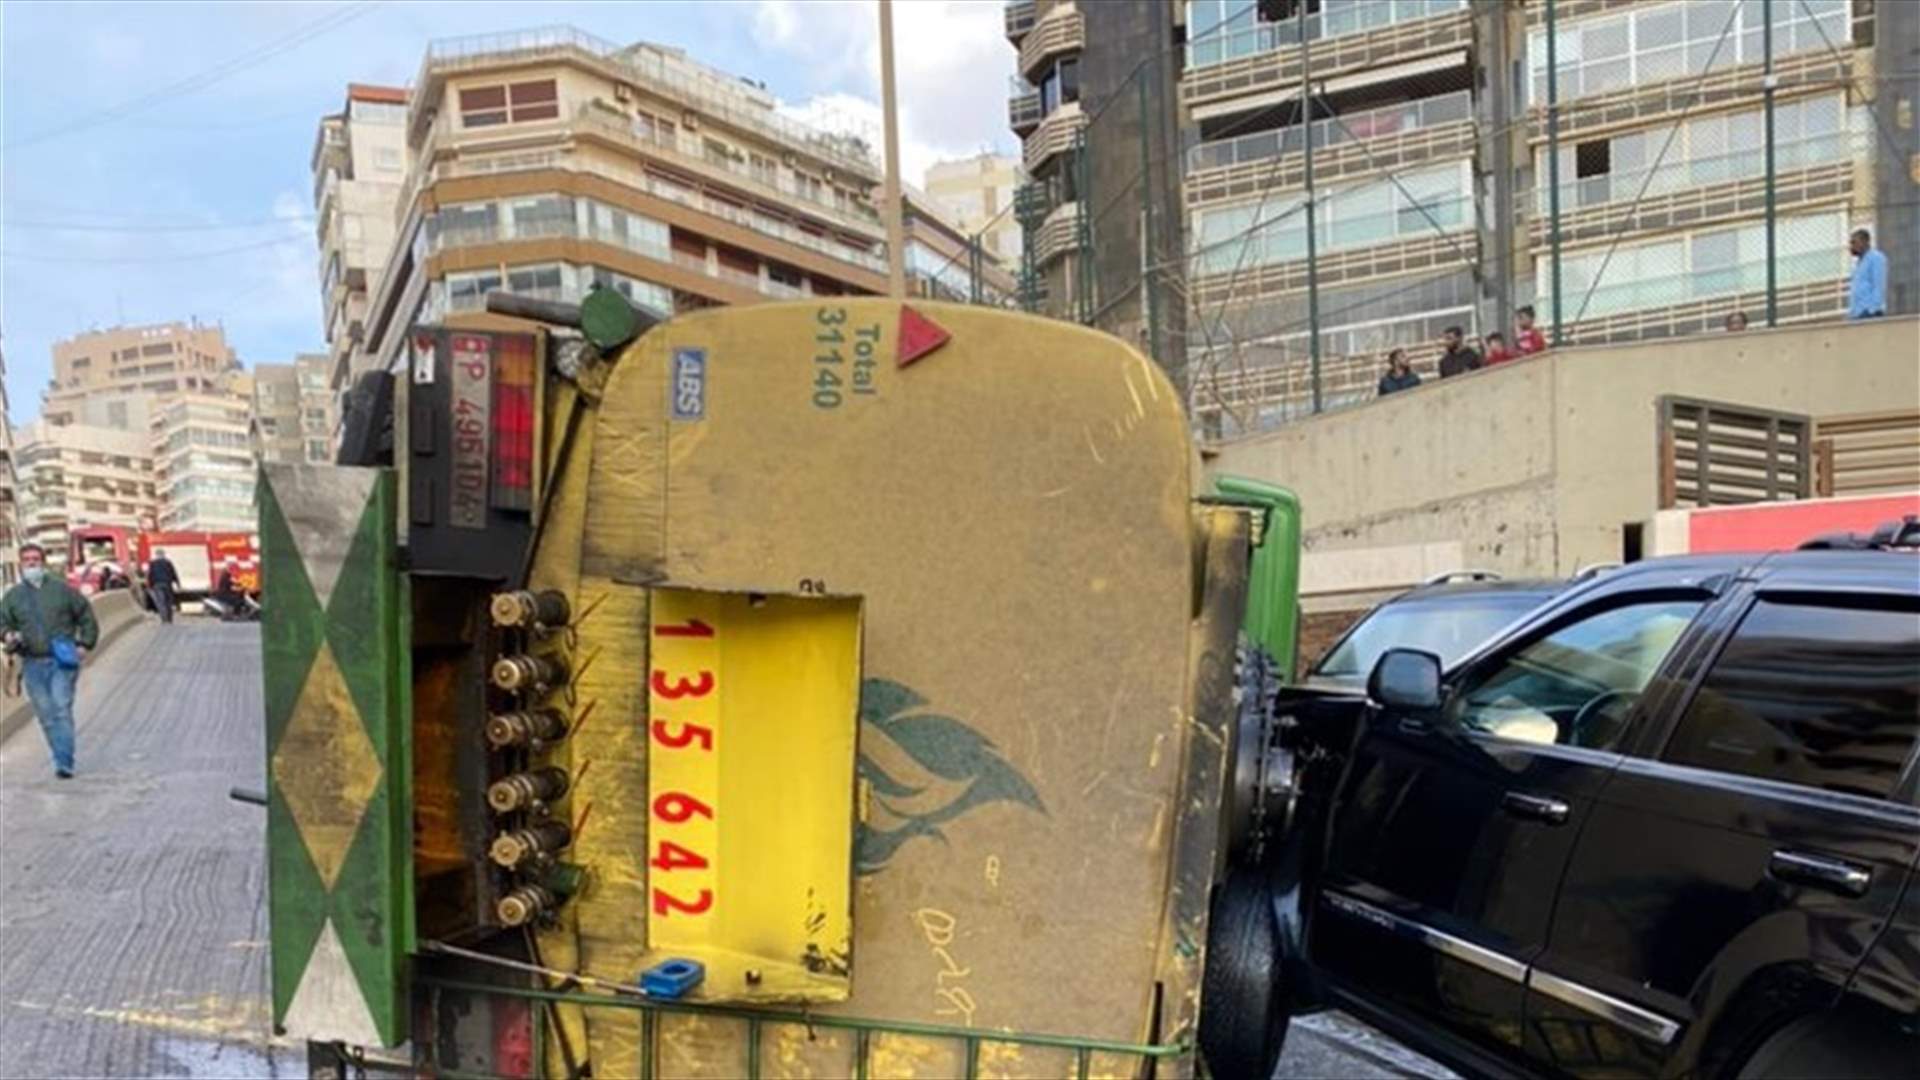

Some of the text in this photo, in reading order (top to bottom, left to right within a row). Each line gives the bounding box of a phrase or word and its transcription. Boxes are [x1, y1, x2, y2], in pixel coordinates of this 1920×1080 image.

[678, 351, 702, 413] ABS
[812, 308, 847, 408] 31140
[852, 323, 880, 395] Total
[651, 791, 714, 917] 642
